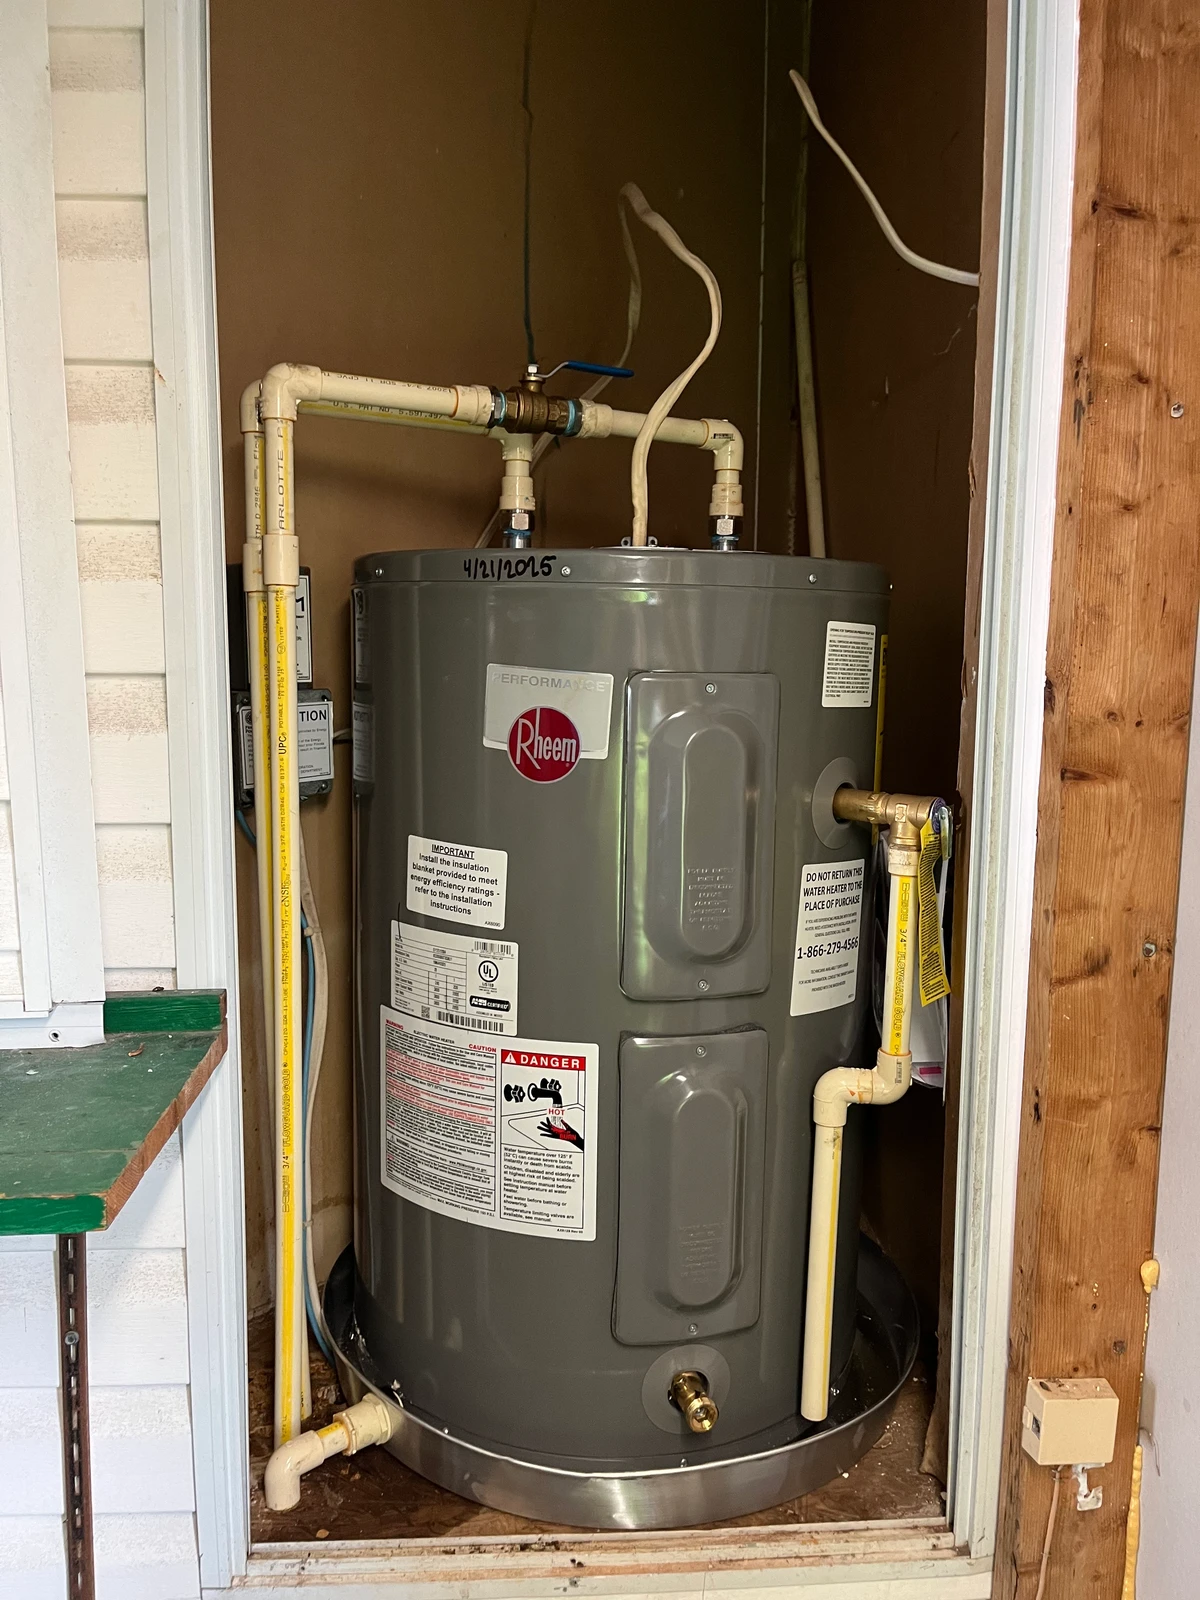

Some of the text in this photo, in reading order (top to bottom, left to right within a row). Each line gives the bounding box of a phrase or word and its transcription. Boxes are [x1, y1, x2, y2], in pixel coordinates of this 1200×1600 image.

[516, 708, 577, 770] Rheem
[432, 844, 475, 860] IMPORTANT
[420, 853, 490, 873] Install the insulation
[412, 862, 498, 885] blanket provided to meet
[806, 866, 862, 882] DO NOT RETURN THIS
[410, 874, 432, 885] energy
[432, 879, 466, 893] efficiency
[468, 884, 494, 898] ratings
[803, 880, 862, 897] WATER HEATER TO THE
[414, 885, 492, 907] refer to the installation
[804, 894, 860, 912] PLACE OF PURCHASE
[430, 900, 472, 915] instructions
[797, 936, 858, 960] 1-866-279-4566
[468, 1044, 496, 1053] CAUTION
[520, 1055, 580, 1068] DANGER
[548, 1108, 565, 1116] HOT
[518, 1149, 545, 1157] temperature
[513, 1178, 537, 1186] instruction
[520, 1184, 547, 1192] temperature
[504, 1206, 531, 1214] Temperature
[532, 1210, 550, 1218] limiting
